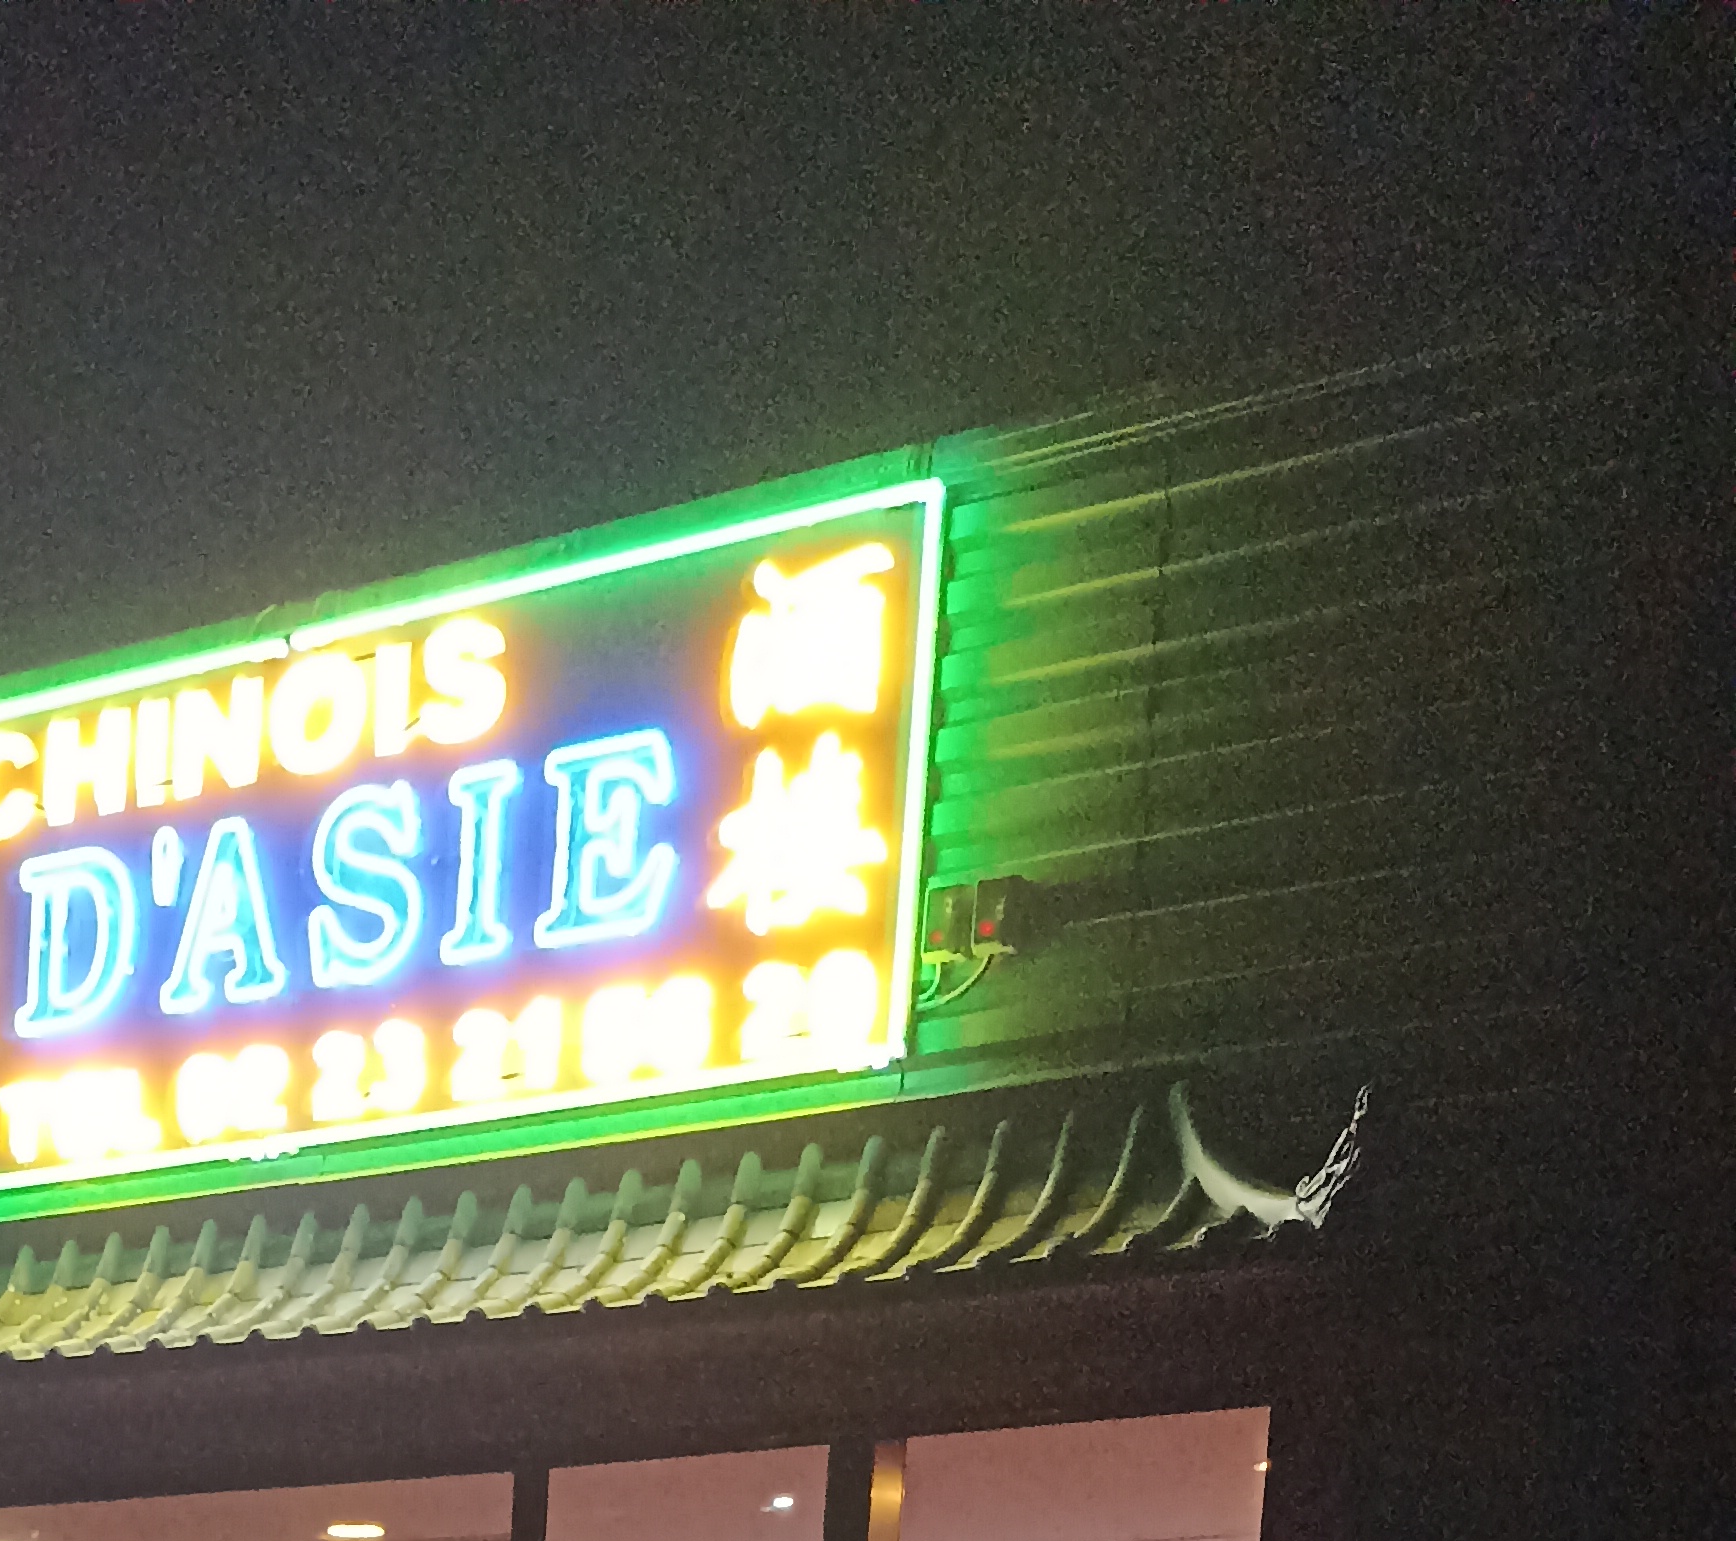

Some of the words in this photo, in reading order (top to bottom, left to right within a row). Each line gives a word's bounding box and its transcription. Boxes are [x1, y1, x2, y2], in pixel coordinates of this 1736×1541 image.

[14, 728, 680, 1041] D'ASIE
[311, 1017, 427, 1122] 23
[450, 994, 564, 1104] 21
